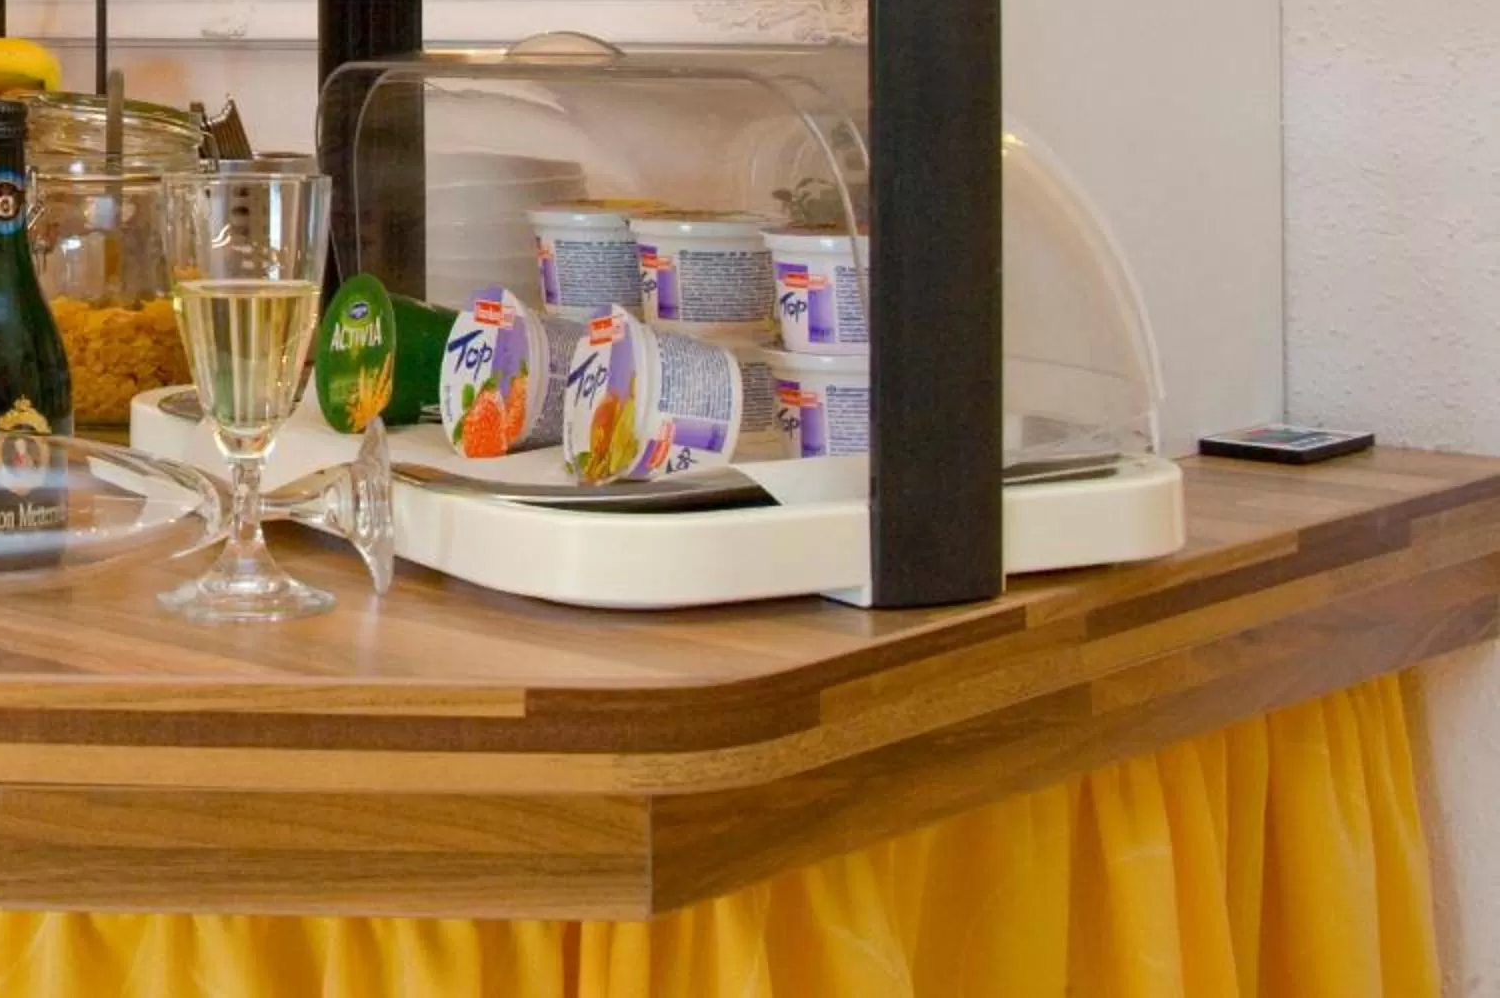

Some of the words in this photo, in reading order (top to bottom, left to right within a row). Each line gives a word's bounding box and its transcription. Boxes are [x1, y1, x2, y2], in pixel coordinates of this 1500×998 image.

[779, 291, 807, 323] Top
[330, 315, 383, 351] ACTIVIA
[447, 329, 493, 382] Top
[566, 351, 607, 410] Top
